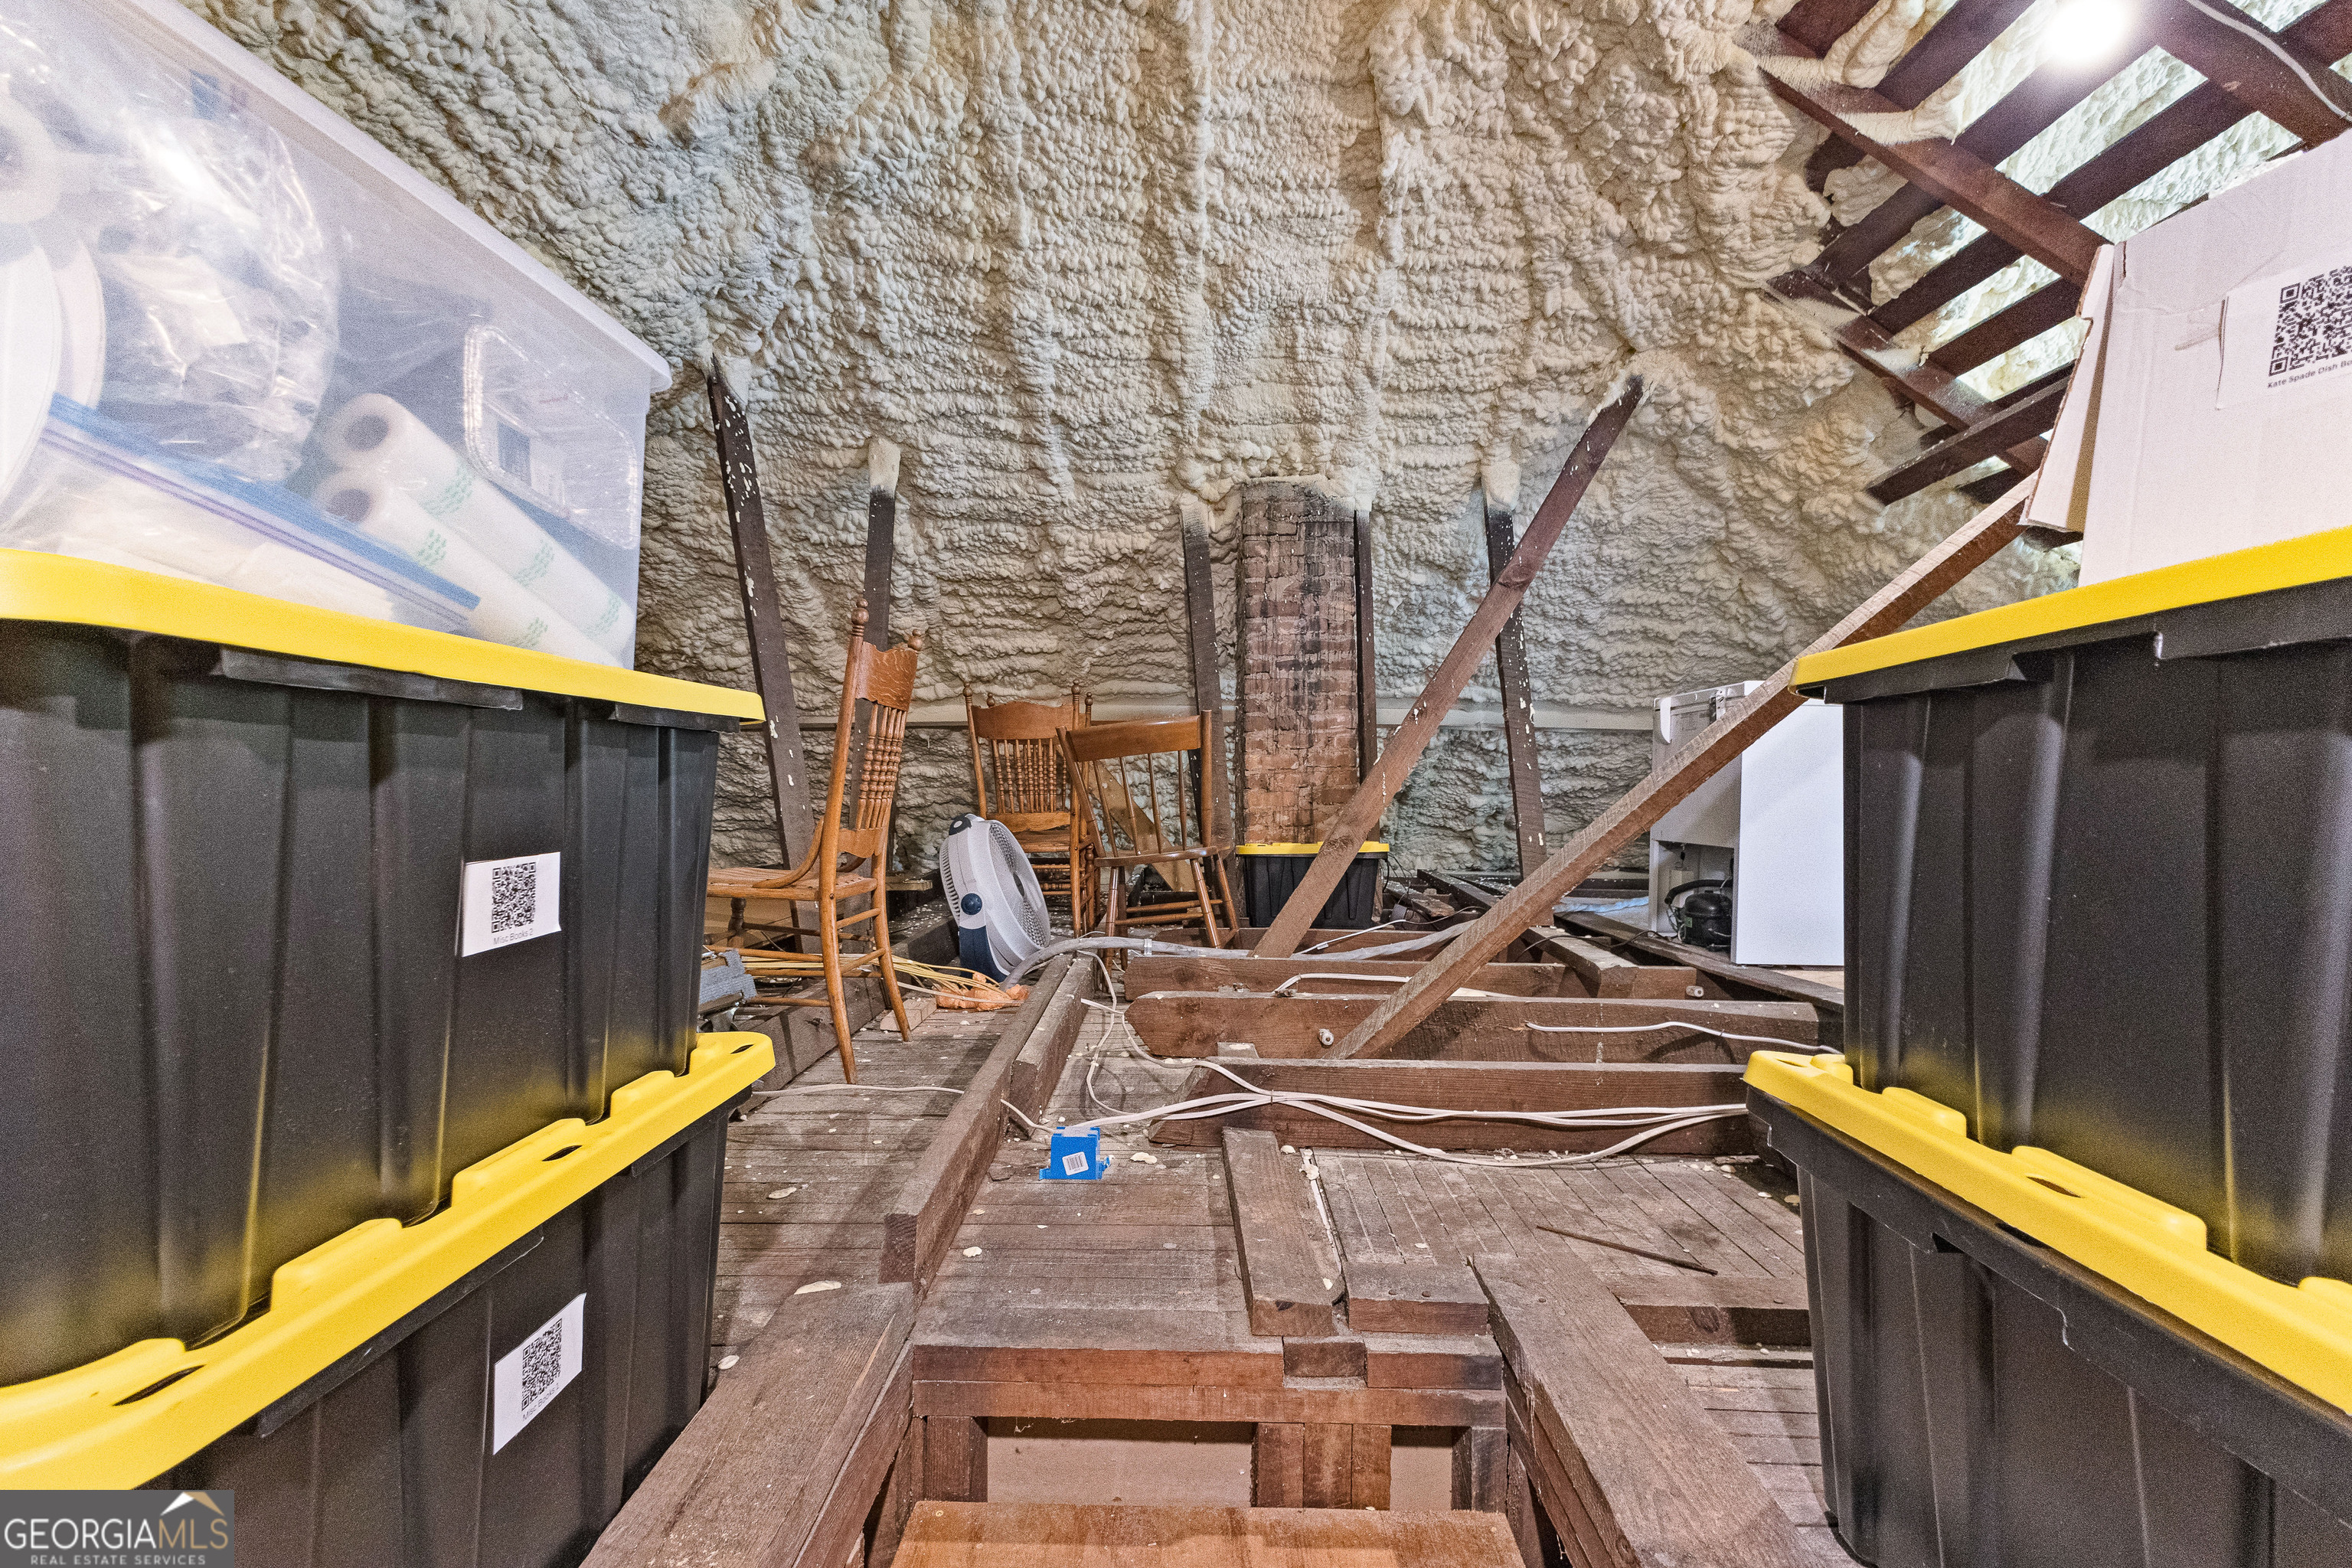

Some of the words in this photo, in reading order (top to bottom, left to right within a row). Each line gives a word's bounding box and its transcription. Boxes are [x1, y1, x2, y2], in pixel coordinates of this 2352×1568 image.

[2267, 379, 2287, 388] Kate
[2288, 371, 2315, 383] Spade
[2318, 364, 2338, 374] Dish
[493, 935, 508, 945] Misc
[510, 930, 528, 941] Books
[529, 928, 534, 936] 2
[522, 1405, 537, 1422] Misc
[538, 1387, 555, 1407] Books
